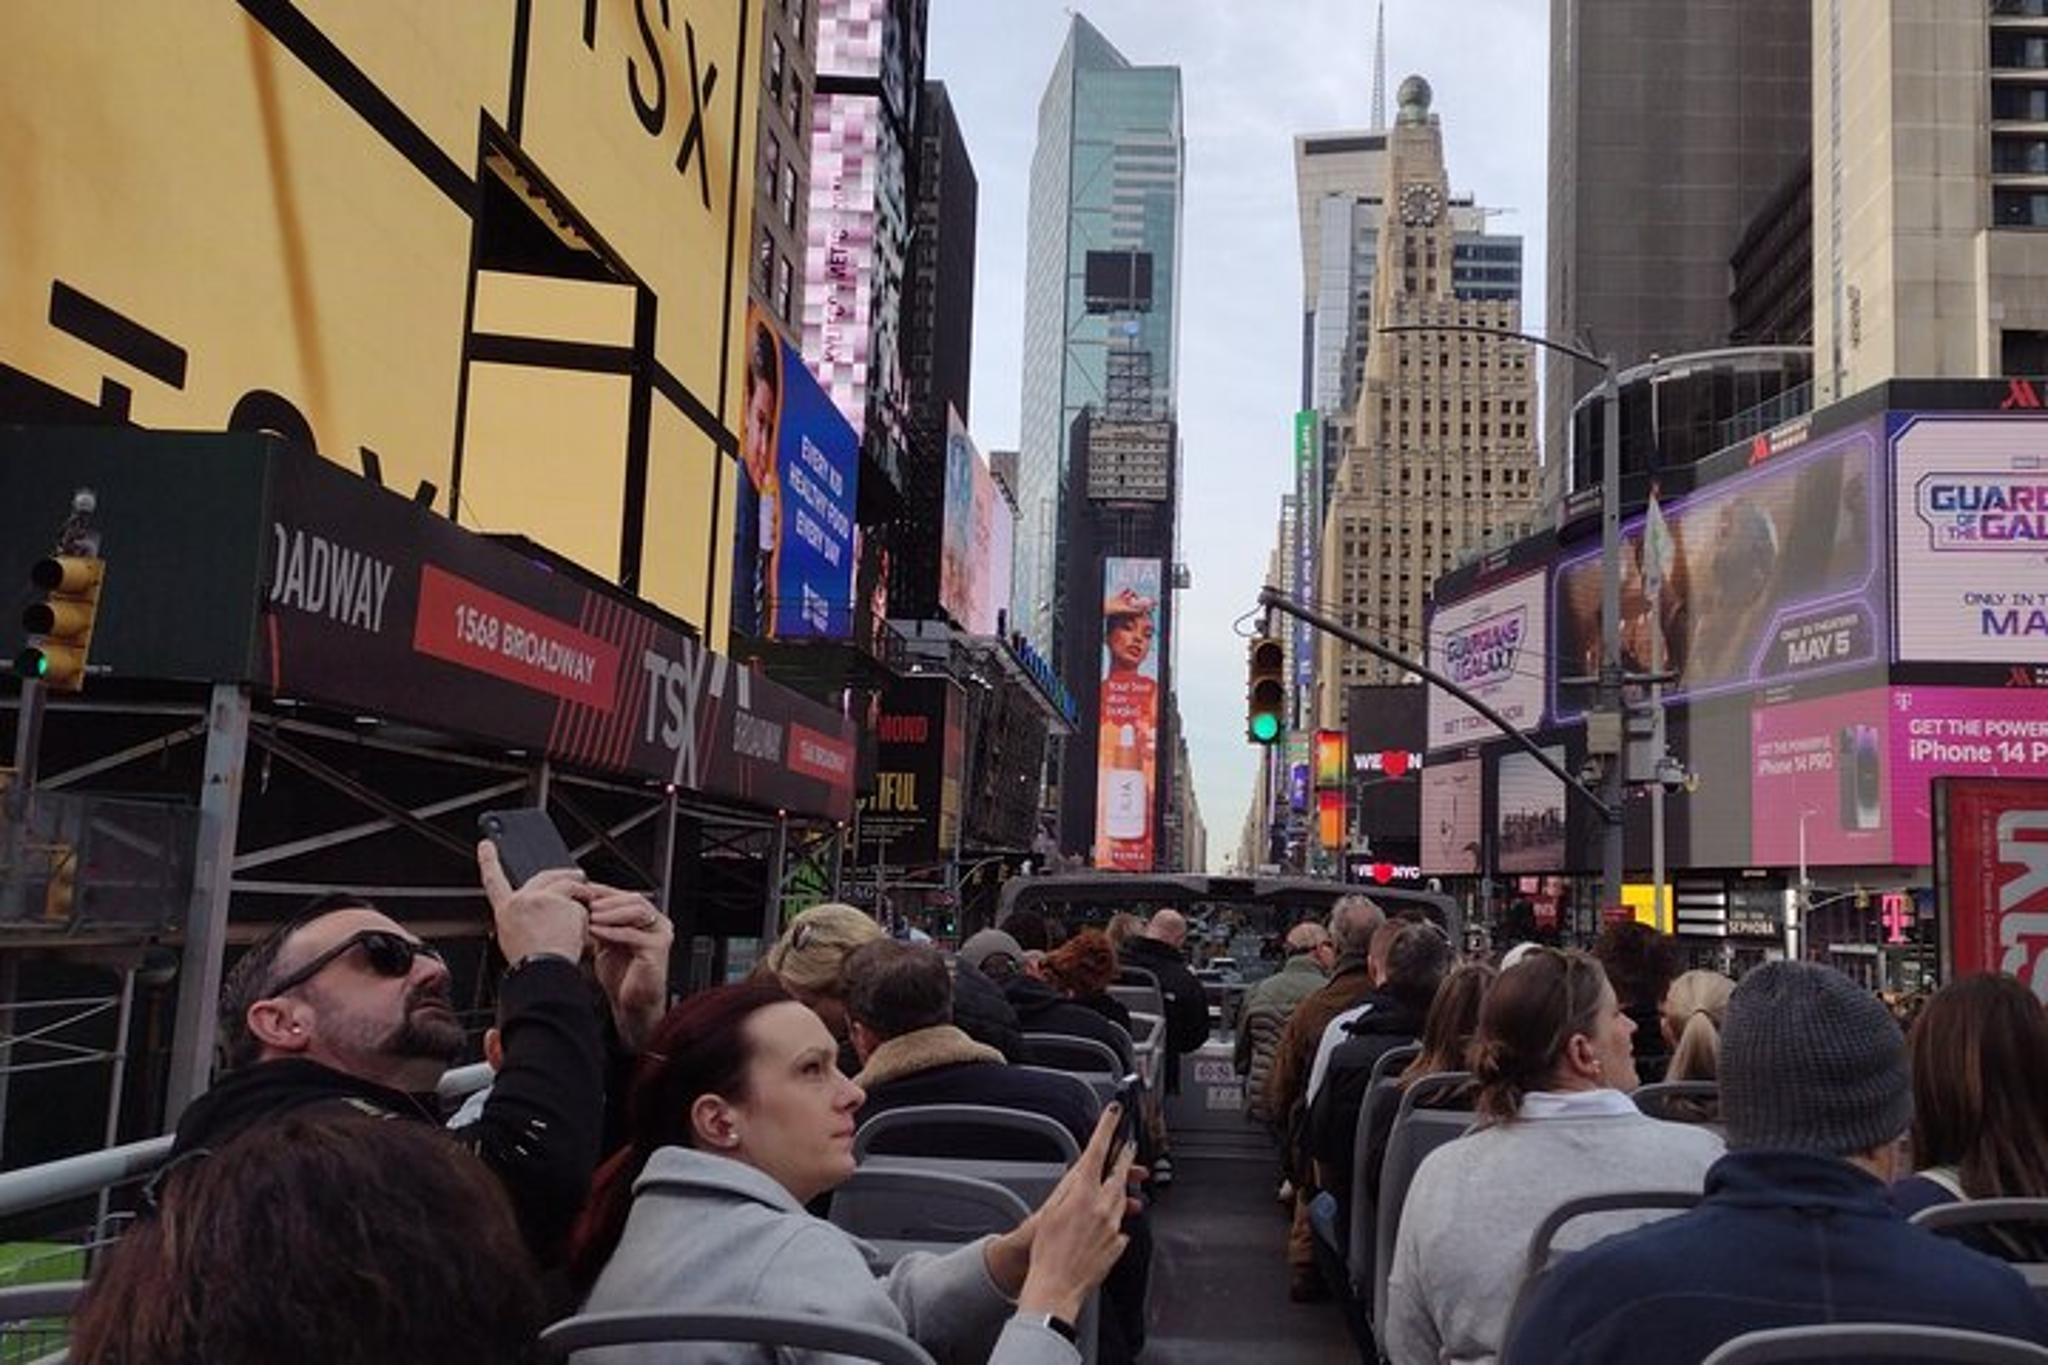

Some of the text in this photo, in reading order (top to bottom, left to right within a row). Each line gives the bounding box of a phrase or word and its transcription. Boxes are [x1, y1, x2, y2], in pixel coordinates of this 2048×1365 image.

[1965, 592, 2006, 606] ONLY
[2013, 593, 2034, 606] IN
[1981, 609, 2048, 636] MA
[455, 604, 597, 685] 1568 BROADWAY
[1788, 630, 1850, 664] MAY 5
[644, 636, 706, 790] TSX
[1910, 719, 1943, 735] GET
[1948, 719, 1982, 736] THE
[1354, 753, 1383, 770] WE
[1910, 739, 1992, 763] iPhone
[1997, 741, 2027, 763] 14
[1729, 920, 1775, 935] SEPHORA
